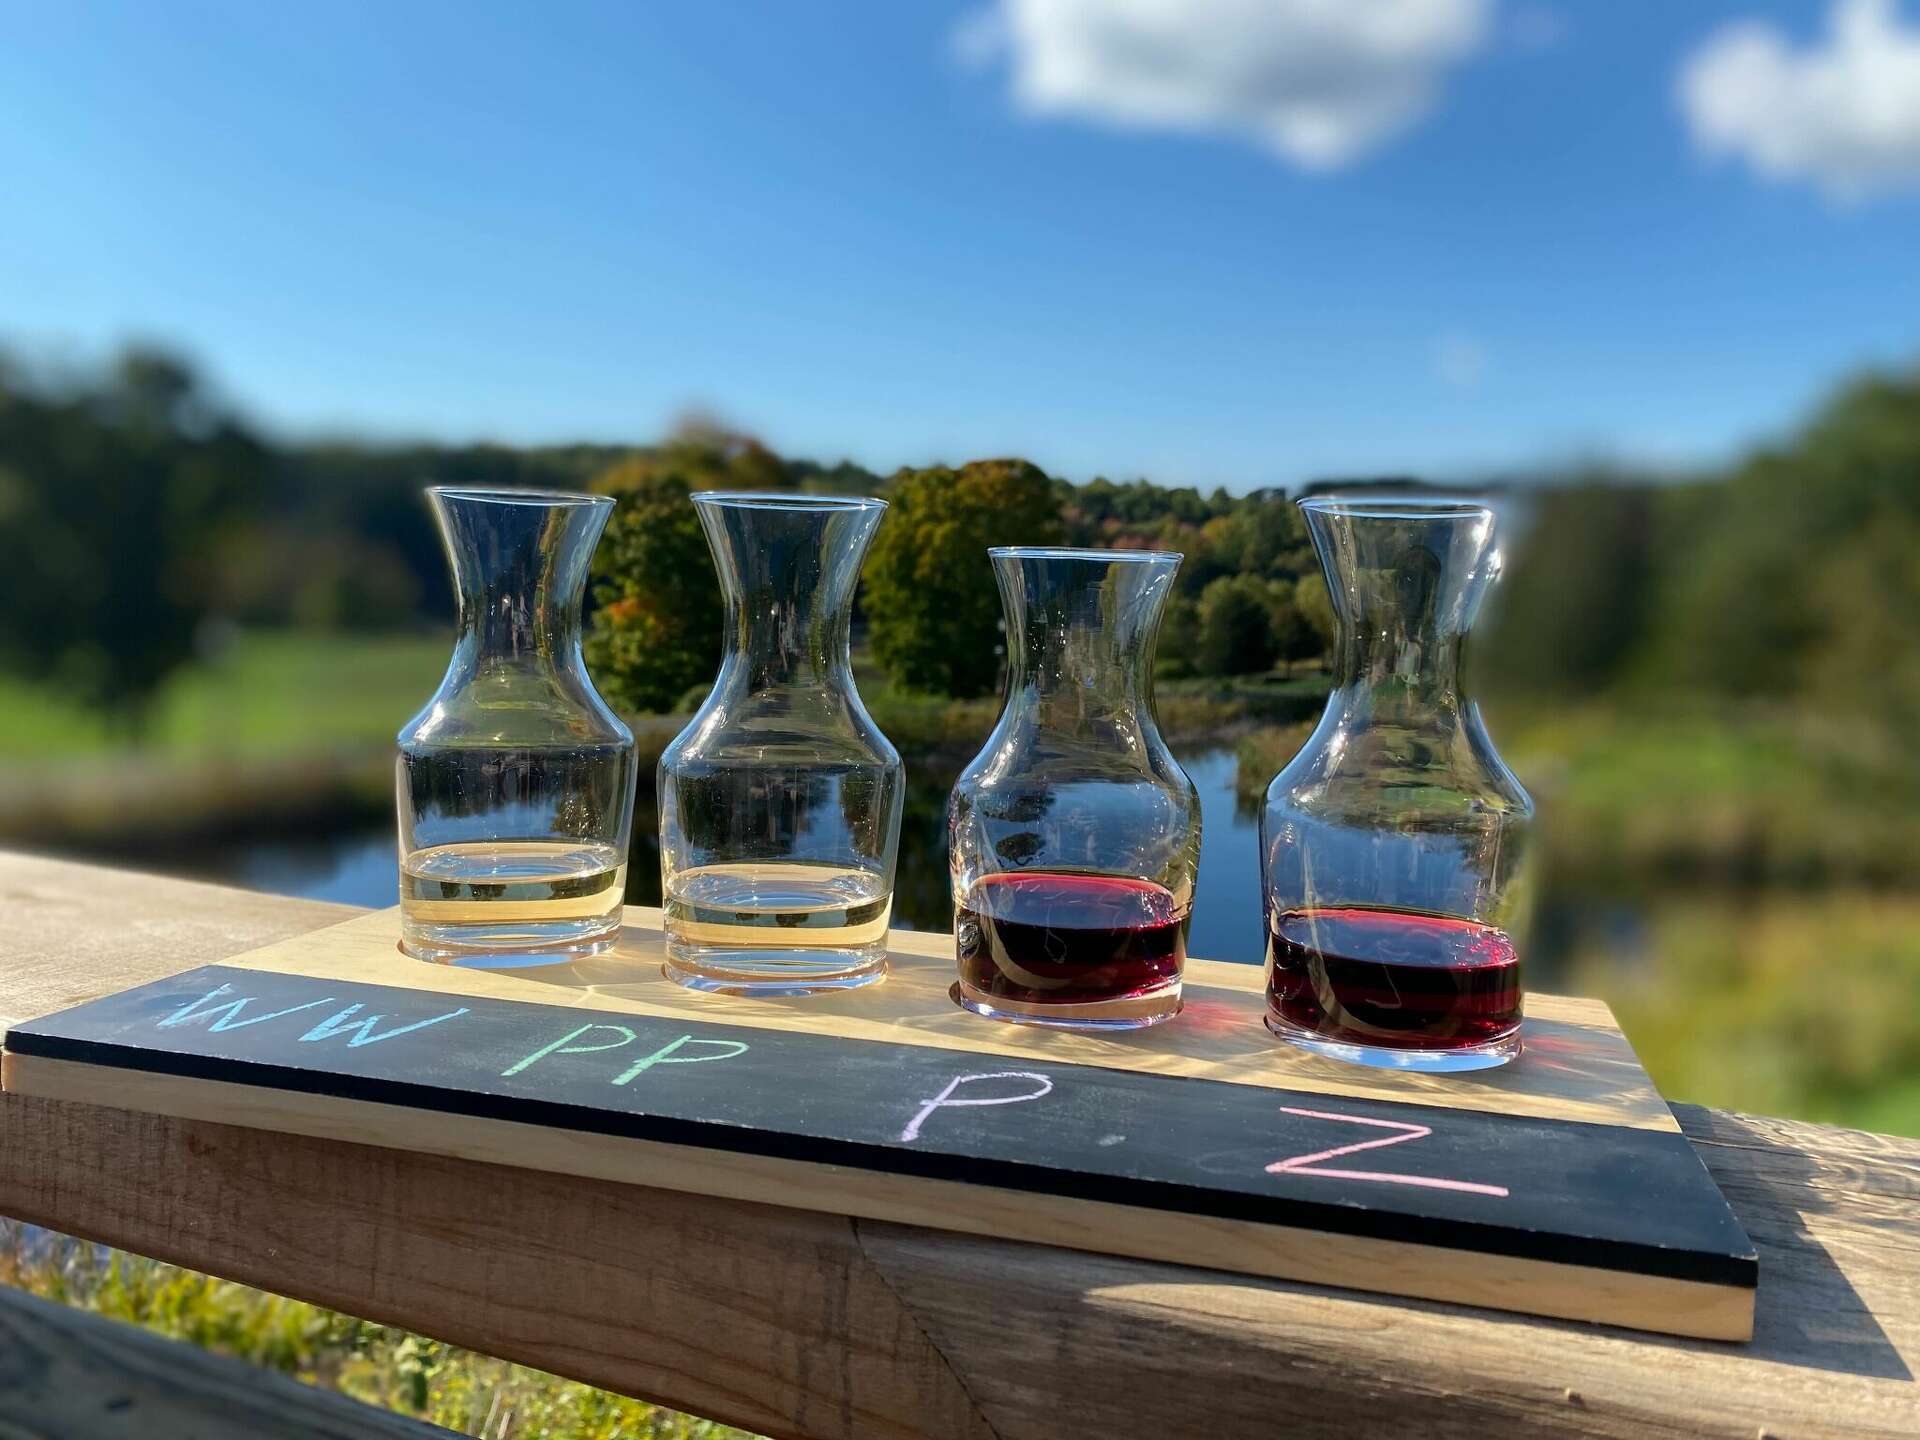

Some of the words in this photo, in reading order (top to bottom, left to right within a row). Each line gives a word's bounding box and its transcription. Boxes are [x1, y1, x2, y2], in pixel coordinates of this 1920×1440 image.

[500, 1023, 750, 1086] PP
[899, 1071, 1054, 1142] P
[1264, 1106, 1510, 1198] Z
